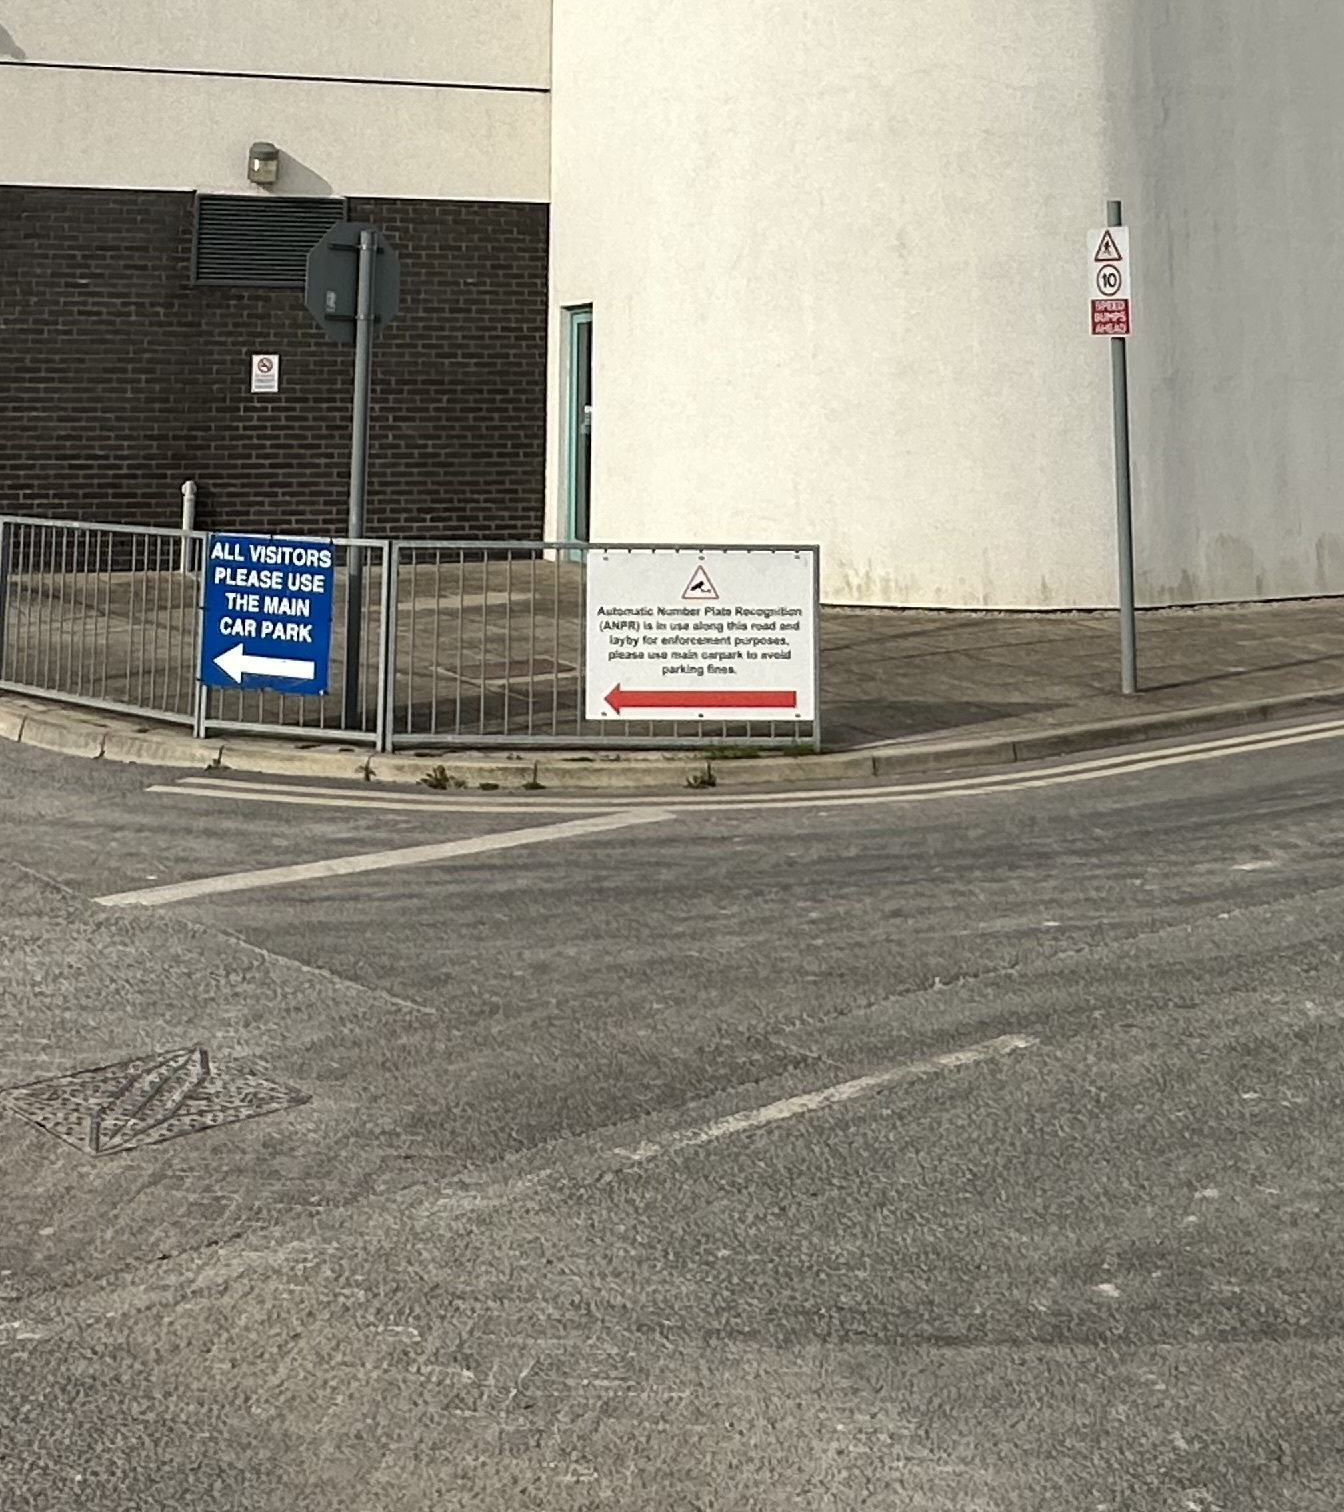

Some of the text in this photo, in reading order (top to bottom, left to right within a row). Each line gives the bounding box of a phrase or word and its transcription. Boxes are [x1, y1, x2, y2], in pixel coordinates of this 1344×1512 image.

[1102, 273, 1117, 288] 10
[1095, 301, 1125, 311] SPEED
[1094, 312, 1127, 322] BUMPS
[1095, 323, 1126, 333] AHEAD
[211, 542, 332, 568] ALL VISITORS
[214, 567, 325, 593] PLEASE USE
[225, 593, 310, 617] THE MAIN
[597, 606, 802, 619] Automatic Number Plate Recognition
[220, 616, 313, 643] CAR PARK
[599, 621, 800, 633] (ANPR) is in use along this road and
[609, 635, 639, 647] layby
[643, 635, 657, 645] for
[661, 635, 732, 646] enforcement
[608, 650, 792, 662] please use main carpark to avoid
[662, 664, 704, 676] parking
